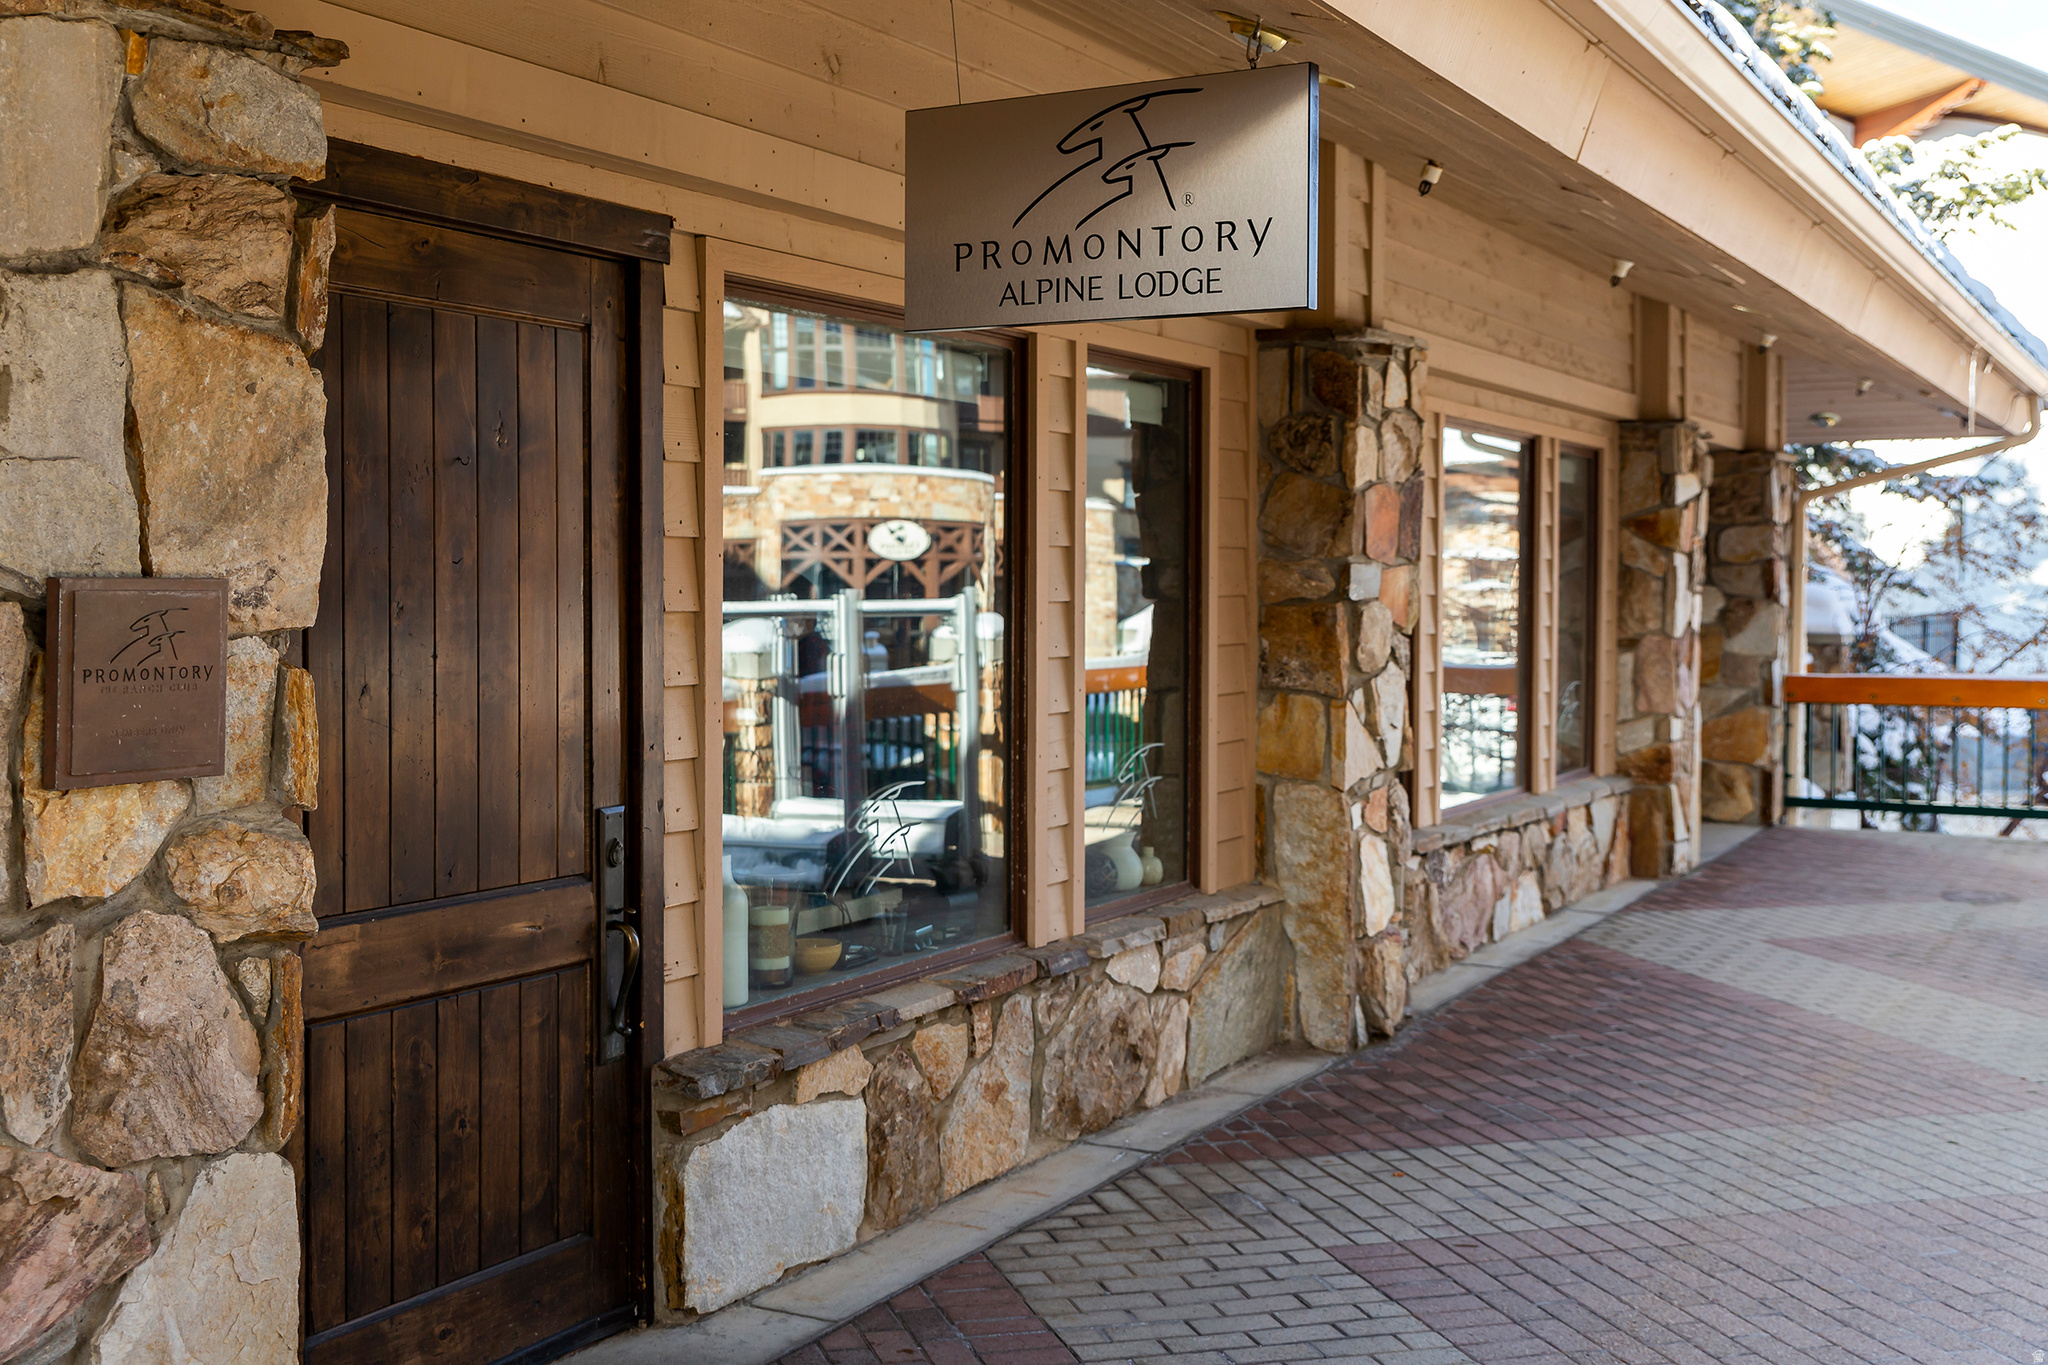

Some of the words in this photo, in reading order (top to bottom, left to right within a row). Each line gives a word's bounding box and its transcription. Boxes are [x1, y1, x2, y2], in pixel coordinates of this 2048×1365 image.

[953, 217, 1273, 272] PROMONTORY
[999, 275, 1104, 307] ALPINE
[1119, 268, 1223, 299] LODGE
[82, 665, 213, 684] PROMONTORY
[123, 685, 163, 694] RANCH
